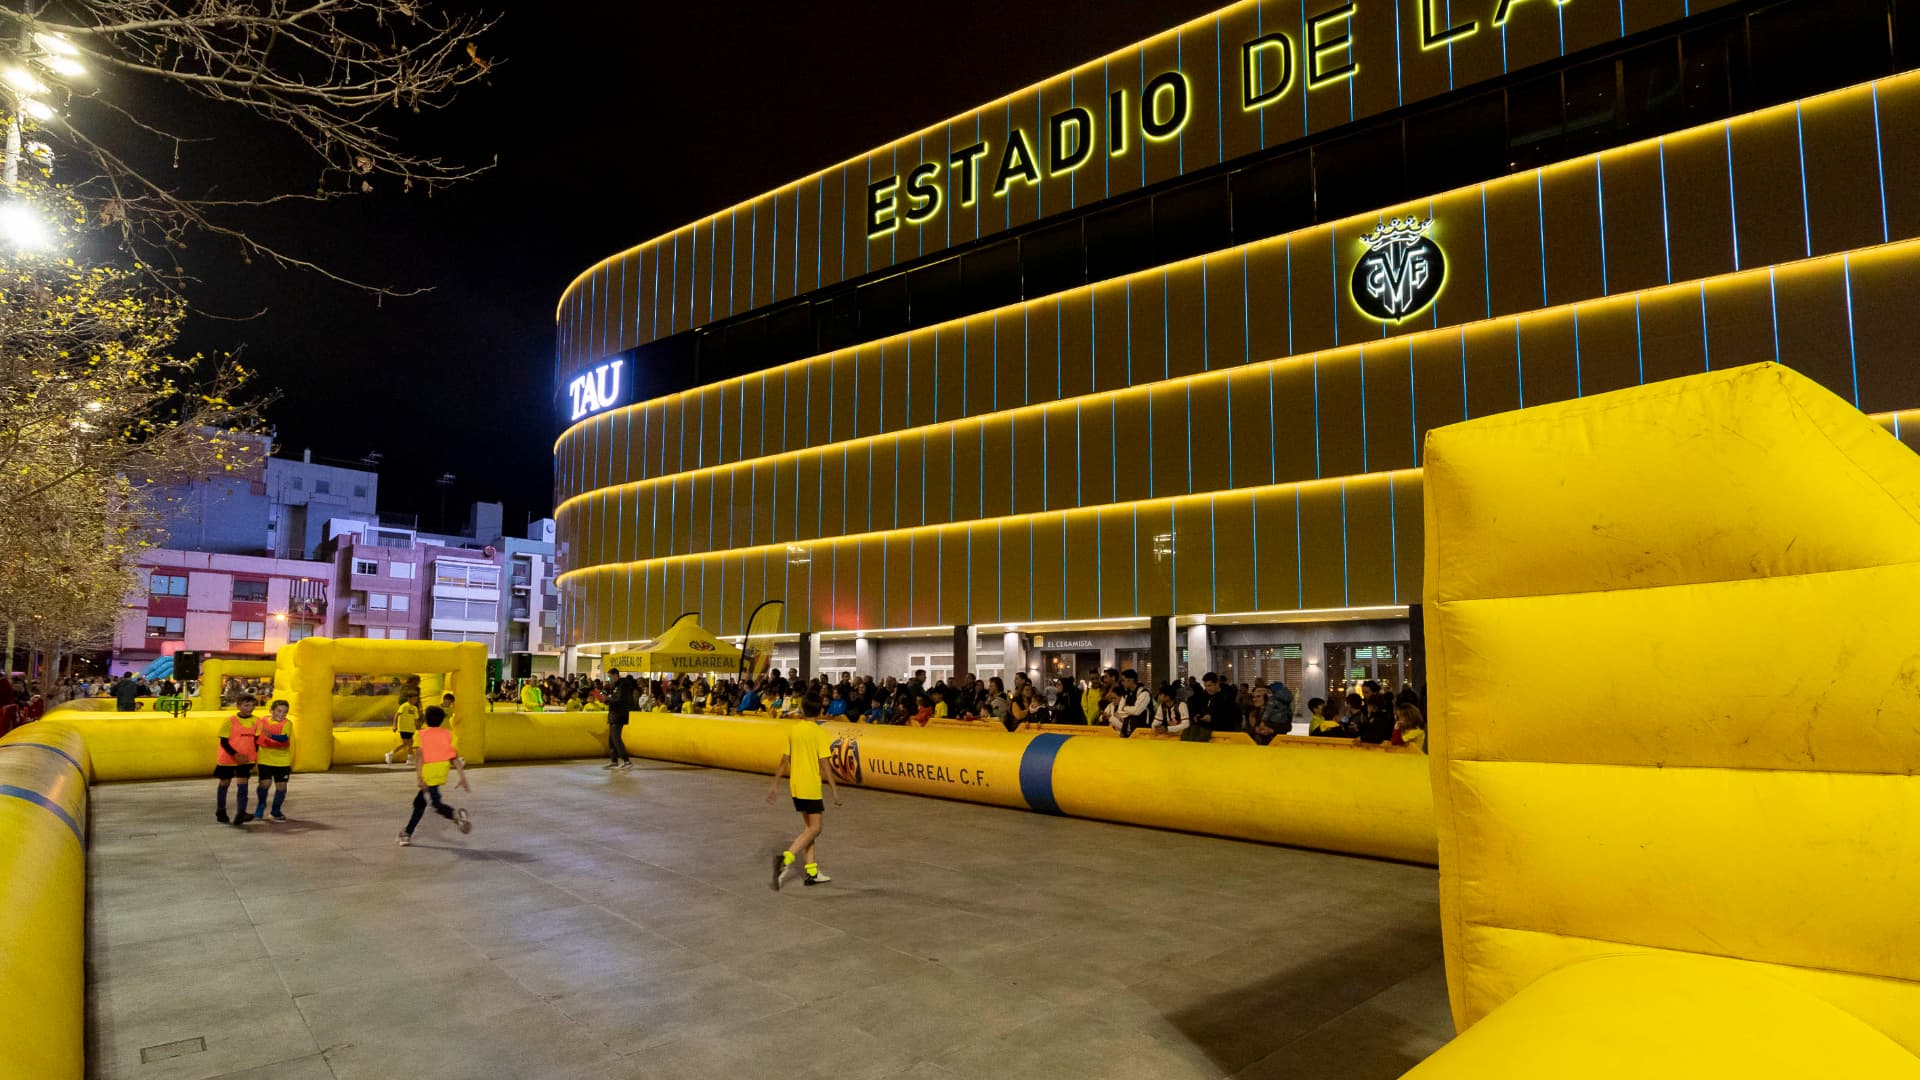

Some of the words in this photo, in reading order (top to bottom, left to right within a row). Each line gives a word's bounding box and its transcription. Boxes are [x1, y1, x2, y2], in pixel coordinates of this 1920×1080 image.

[866, 71, 1191, 239] ESTADIO
[1241, 3, 1360, 112] DE
[569, 359, 624, 421] TAU
[1055, 640, 1093, 648] CERAMISTA
[671, 655, 736, 669] VILLARREAL
[868, 758, 955, 783] VILLARREAL
[959, 768, 990, 788] C.F.
